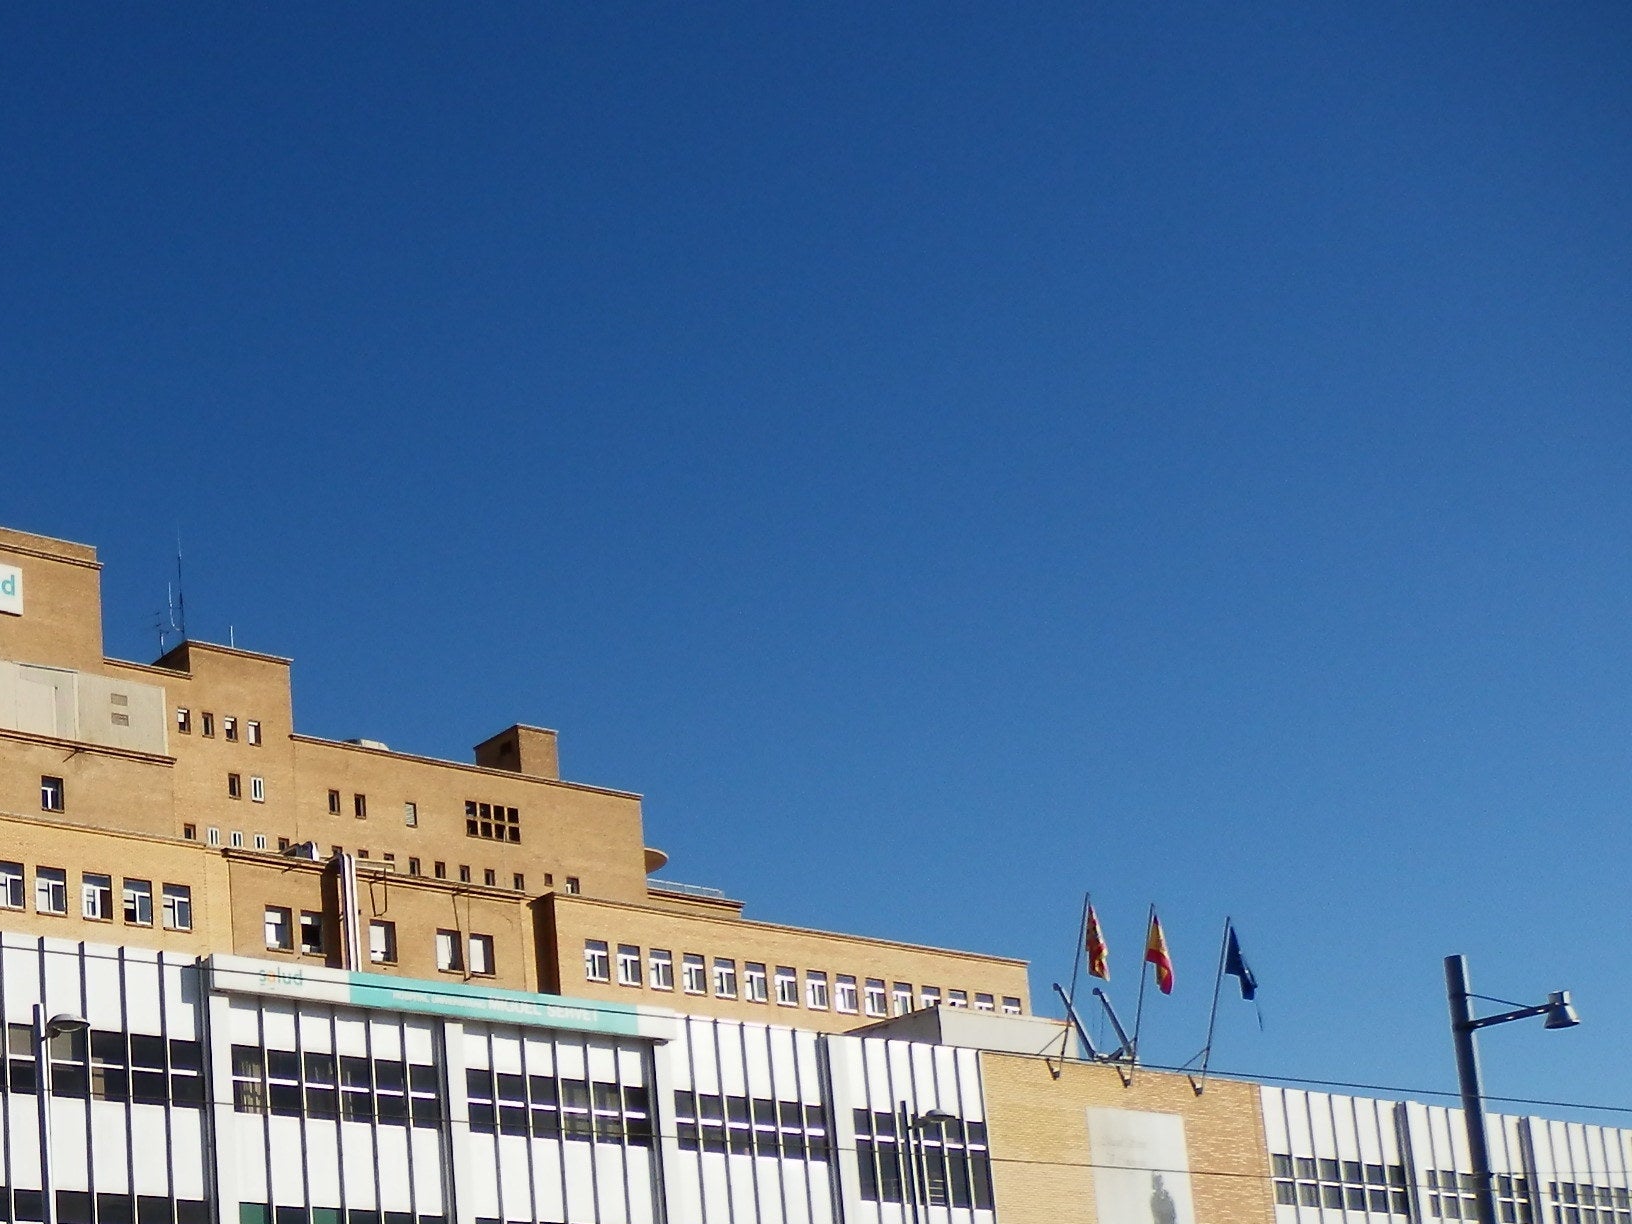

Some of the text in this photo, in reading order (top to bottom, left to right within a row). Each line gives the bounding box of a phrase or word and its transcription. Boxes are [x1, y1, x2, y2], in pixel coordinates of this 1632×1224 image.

[258, 966, 304, 986] salud
[488, 995, 542, 1016] MIGUEL
[546, 1005, 599, 1022] SERVET
